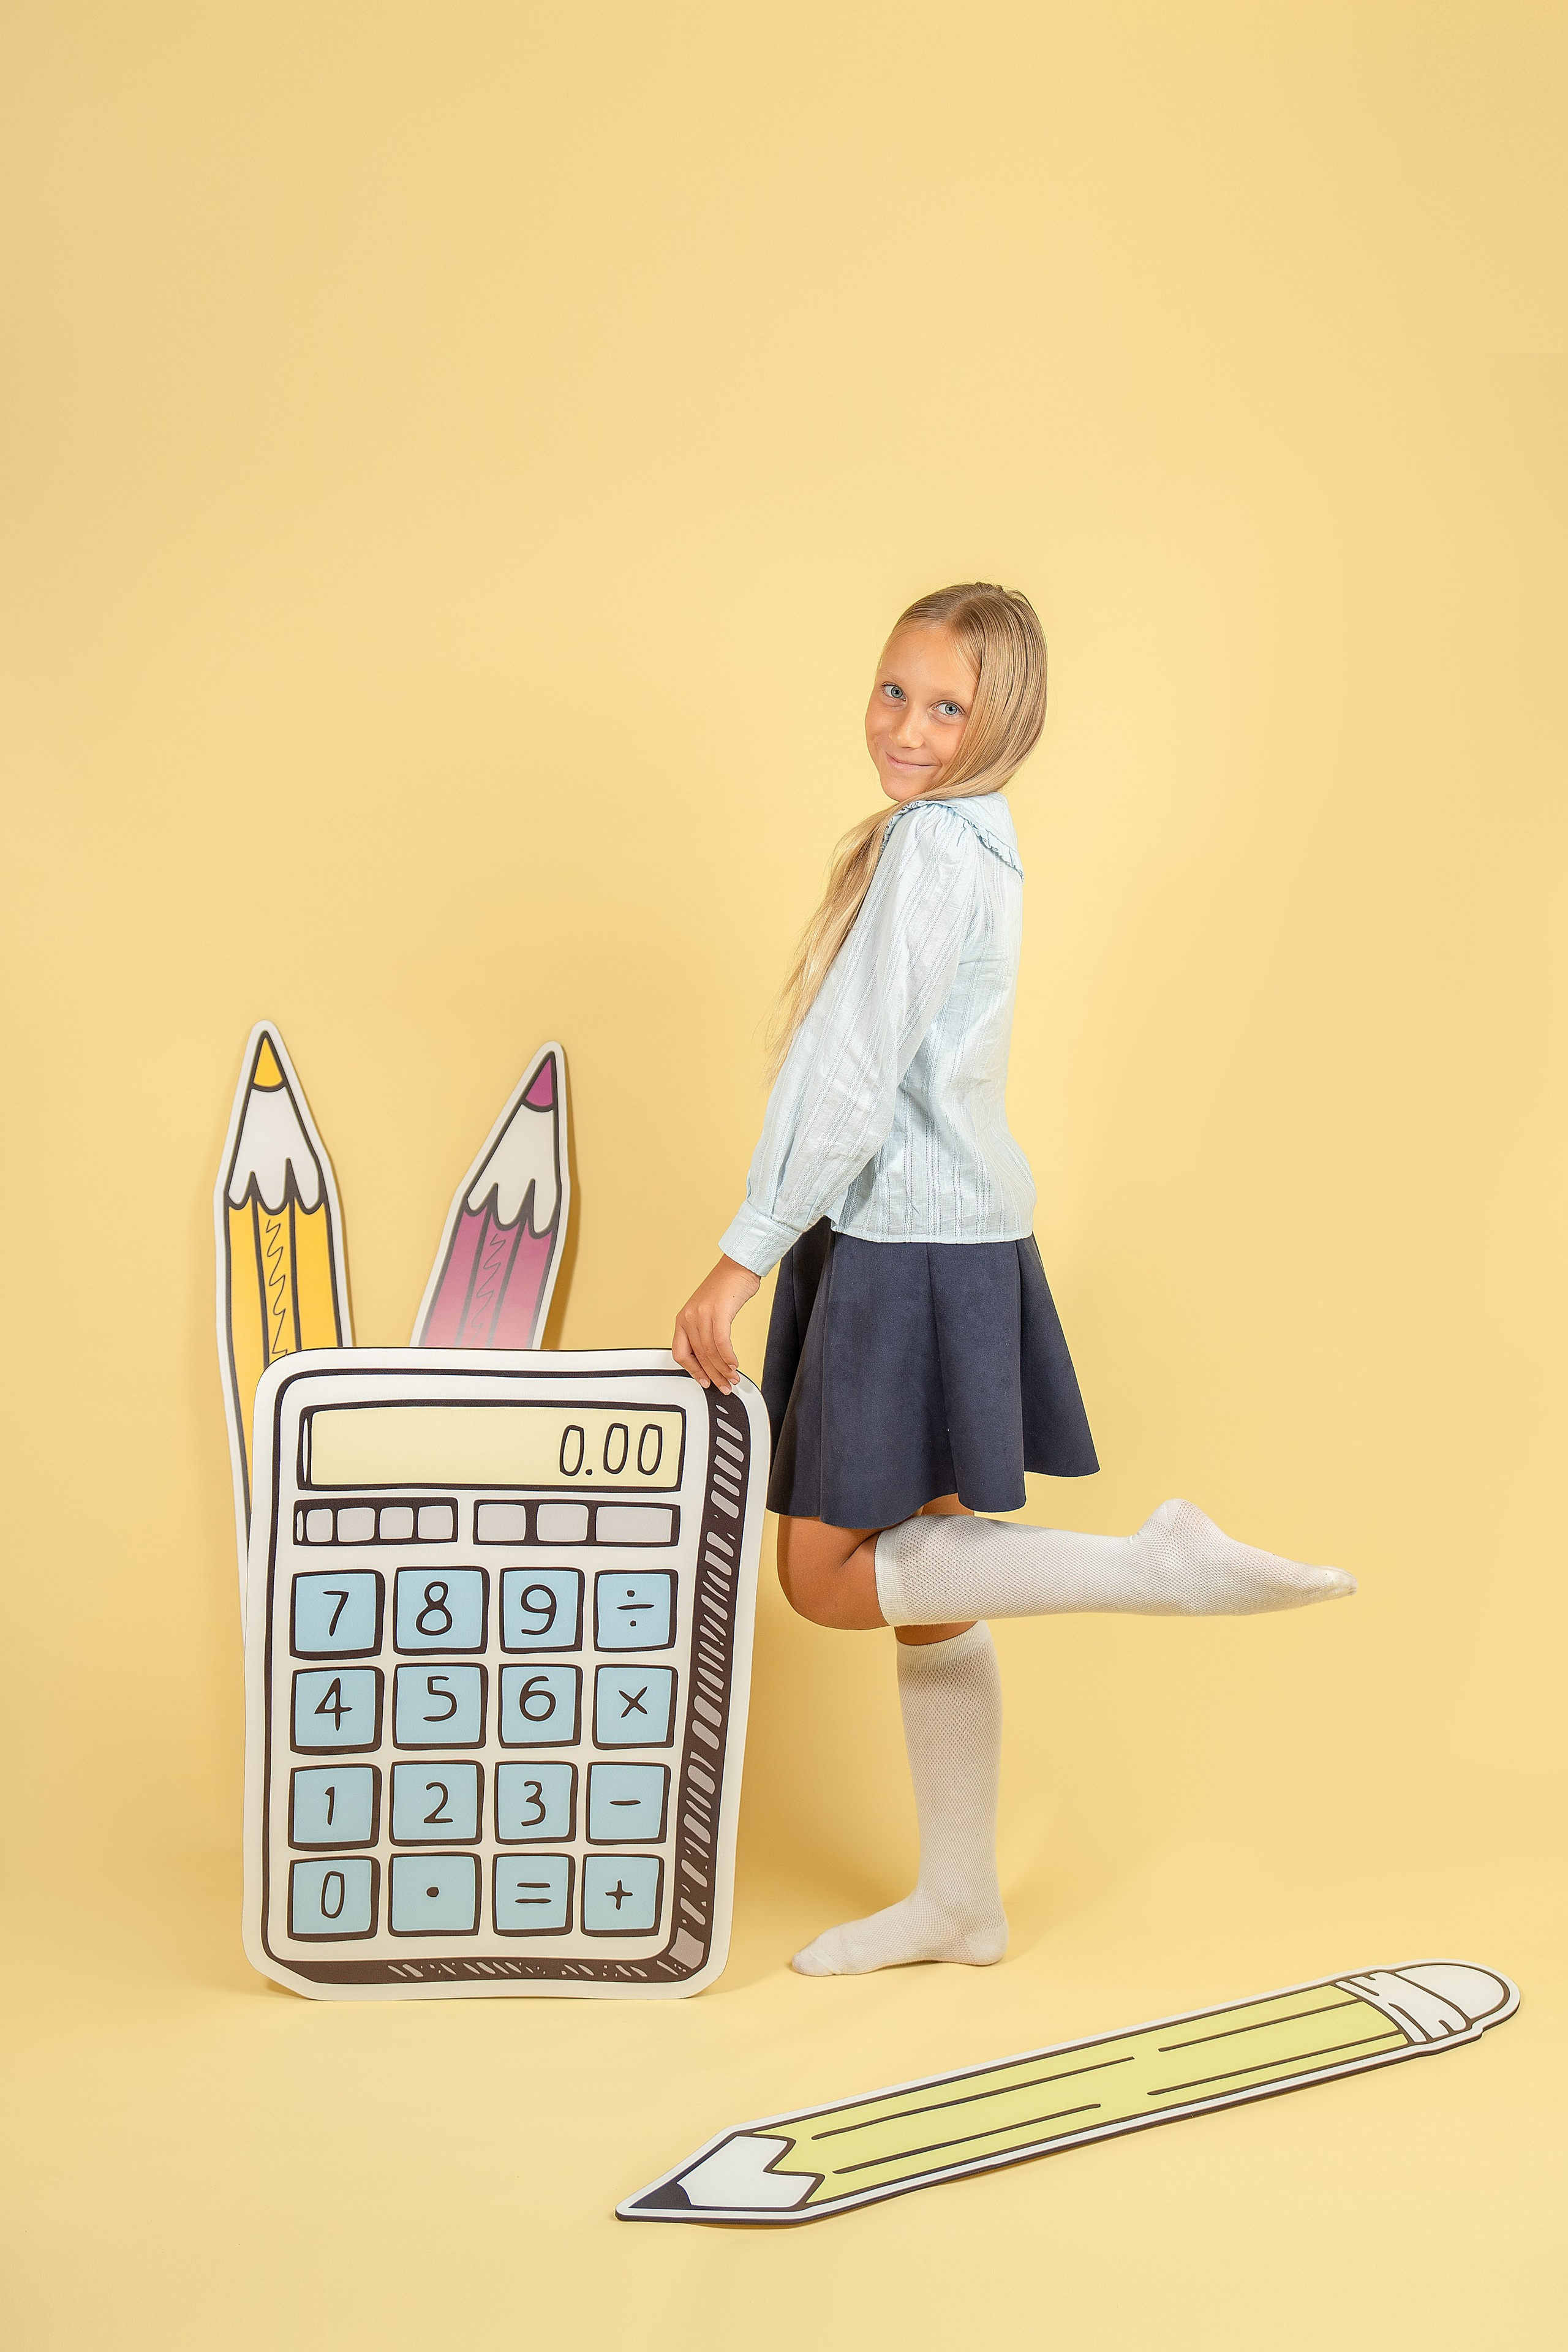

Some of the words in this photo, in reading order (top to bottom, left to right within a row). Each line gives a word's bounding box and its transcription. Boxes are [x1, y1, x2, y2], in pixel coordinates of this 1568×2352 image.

[559, 1422, 663, 1477] 0.00
[322, 1589, 350, 1638] 7
[415, 1580, 453, 1637] 8
[520, 1583, 558, 1637] 9
[313, 1676, 353, 1732] 4
[422, 1675, 458, 1723] 5
[518, 1675, 557, 1723] 6
[323, 1785, 336, 1826] 1
[423, 1781, 454, 1825] 2
[520, 1780, 547, 1827] 3
[320, 1870, 346, 1920] 0
